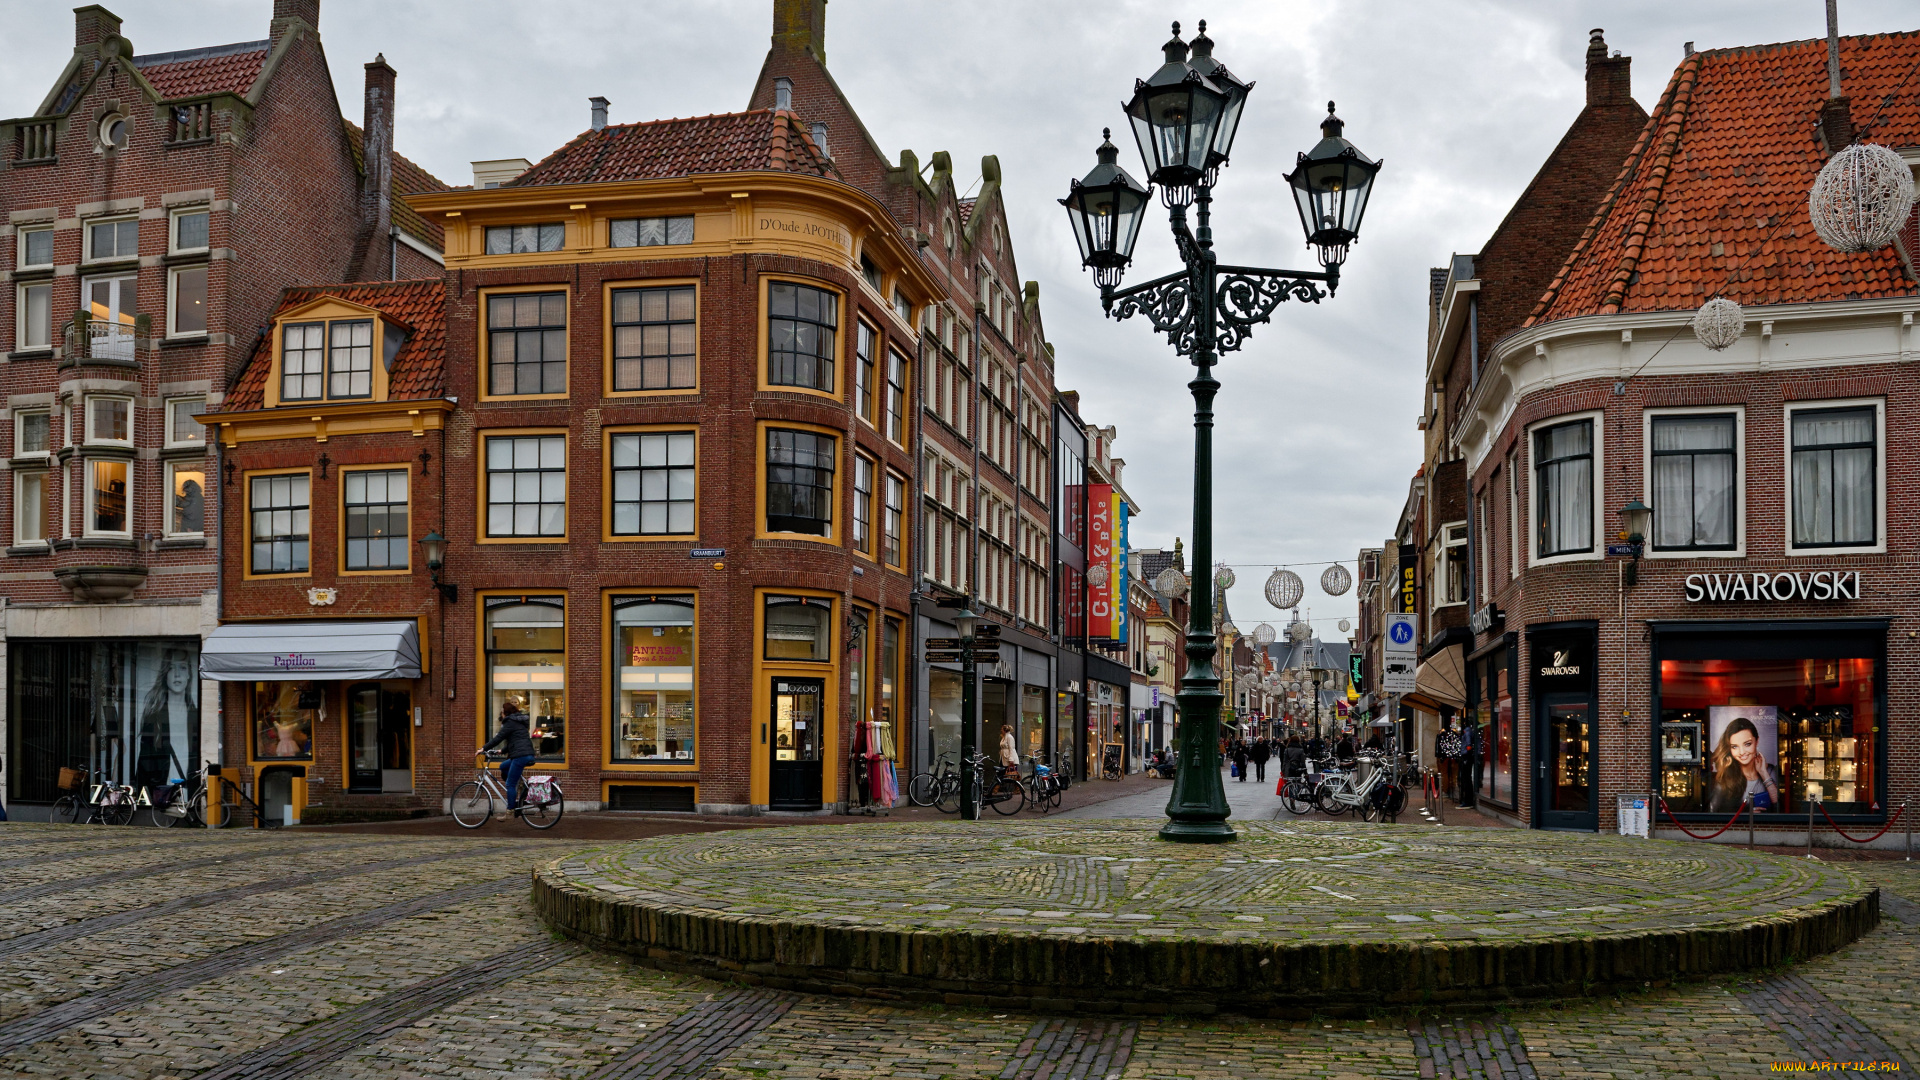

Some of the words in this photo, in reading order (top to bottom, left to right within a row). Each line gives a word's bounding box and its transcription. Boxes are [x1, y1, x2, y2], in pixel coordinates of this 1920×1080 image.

[760, 218, 800, 233] D'Oude
[1402, 567, 1415, 613] acha
[1685, 571, 1861, 602] SWAROVSKI
[626, 646, 683, 655] FANTASIA
[274, 653, 316, 670] Papillon
[1541, 665, 1580, 676] SWAROVSKI
[788, 685, 818, 693] OZOO
[90, 784, 152, 806] ZRA
